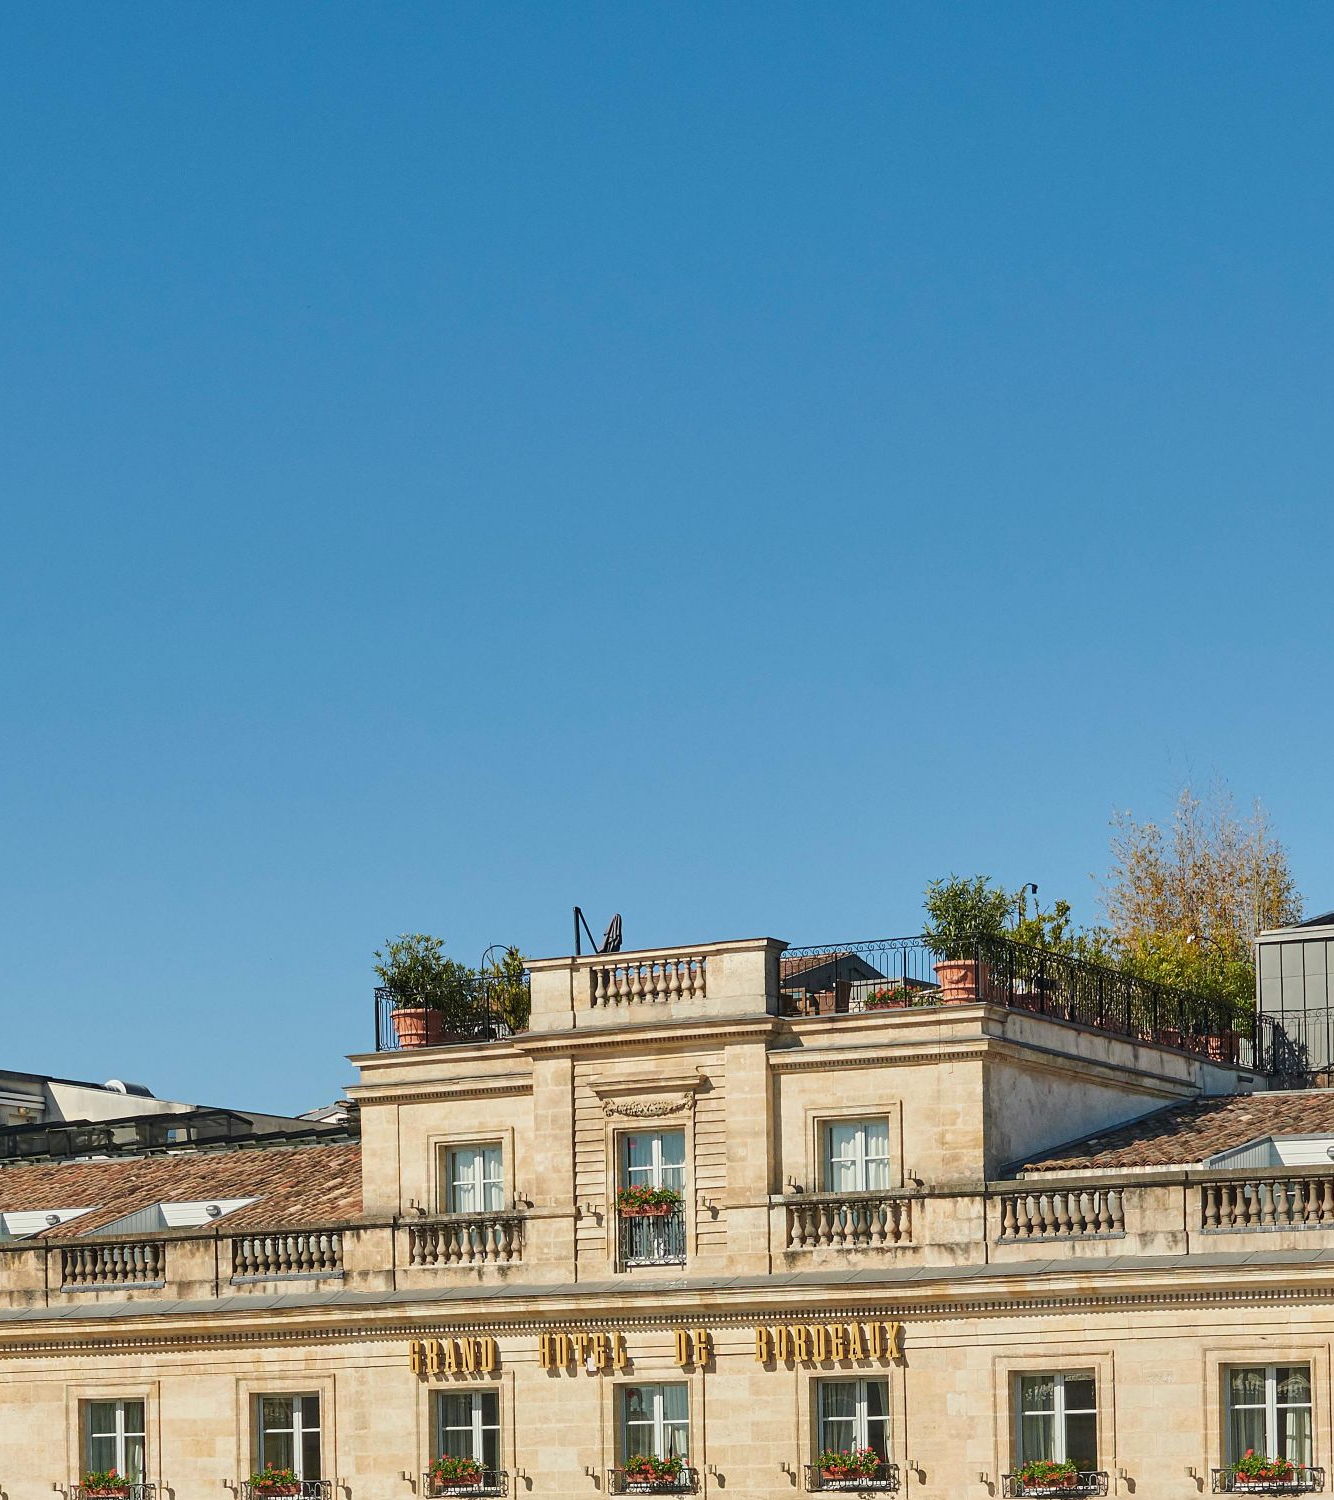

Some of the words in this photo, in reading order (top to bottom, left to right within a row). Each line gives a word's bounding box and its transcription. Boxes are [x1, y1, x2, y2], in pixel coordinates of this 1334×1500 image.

[409, 1337, 496, 1374] GRAND
[538, 1331, 628, 1370] HOTEL
[673, 1328, 708, 1366] DE
[755, 1321, 902, 1362] BORDEAUX
